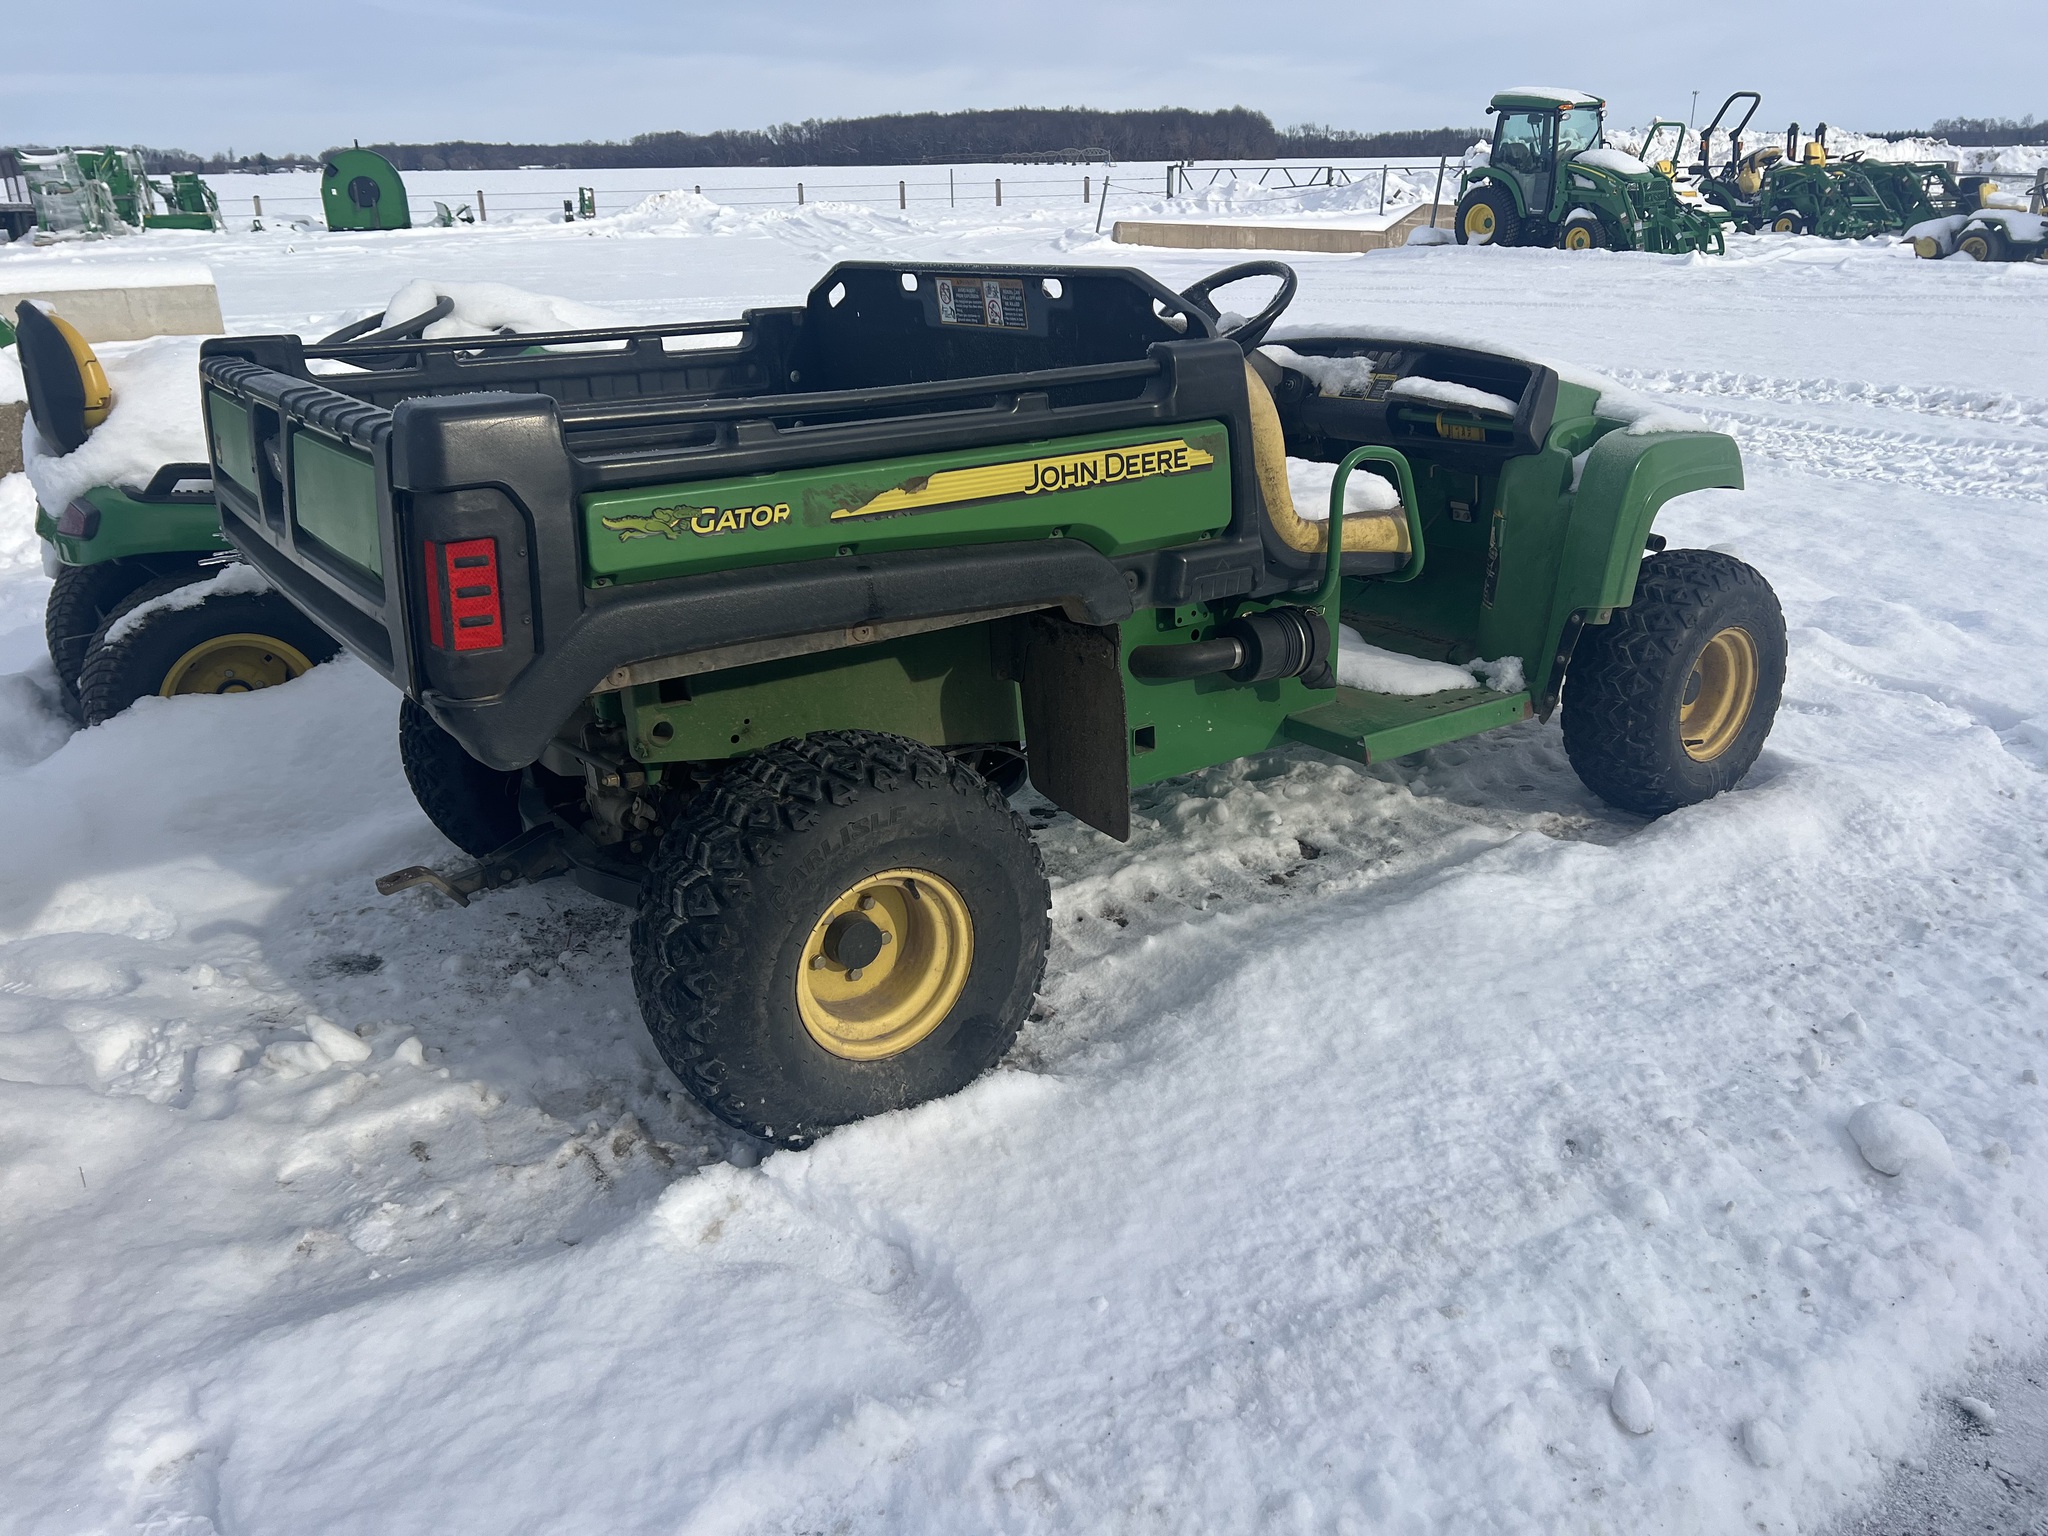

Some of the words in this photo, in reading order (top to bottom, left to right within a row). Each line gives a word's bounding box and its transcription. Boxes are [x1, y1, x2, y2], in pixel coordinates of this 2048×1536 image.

[1024, 459, 1098, 491] JOHN
[1105, 447, 1188, 479] DEERE
[689, 502, 791, 536] GATOR
[770, 806, 907, 911] CARLISLE
